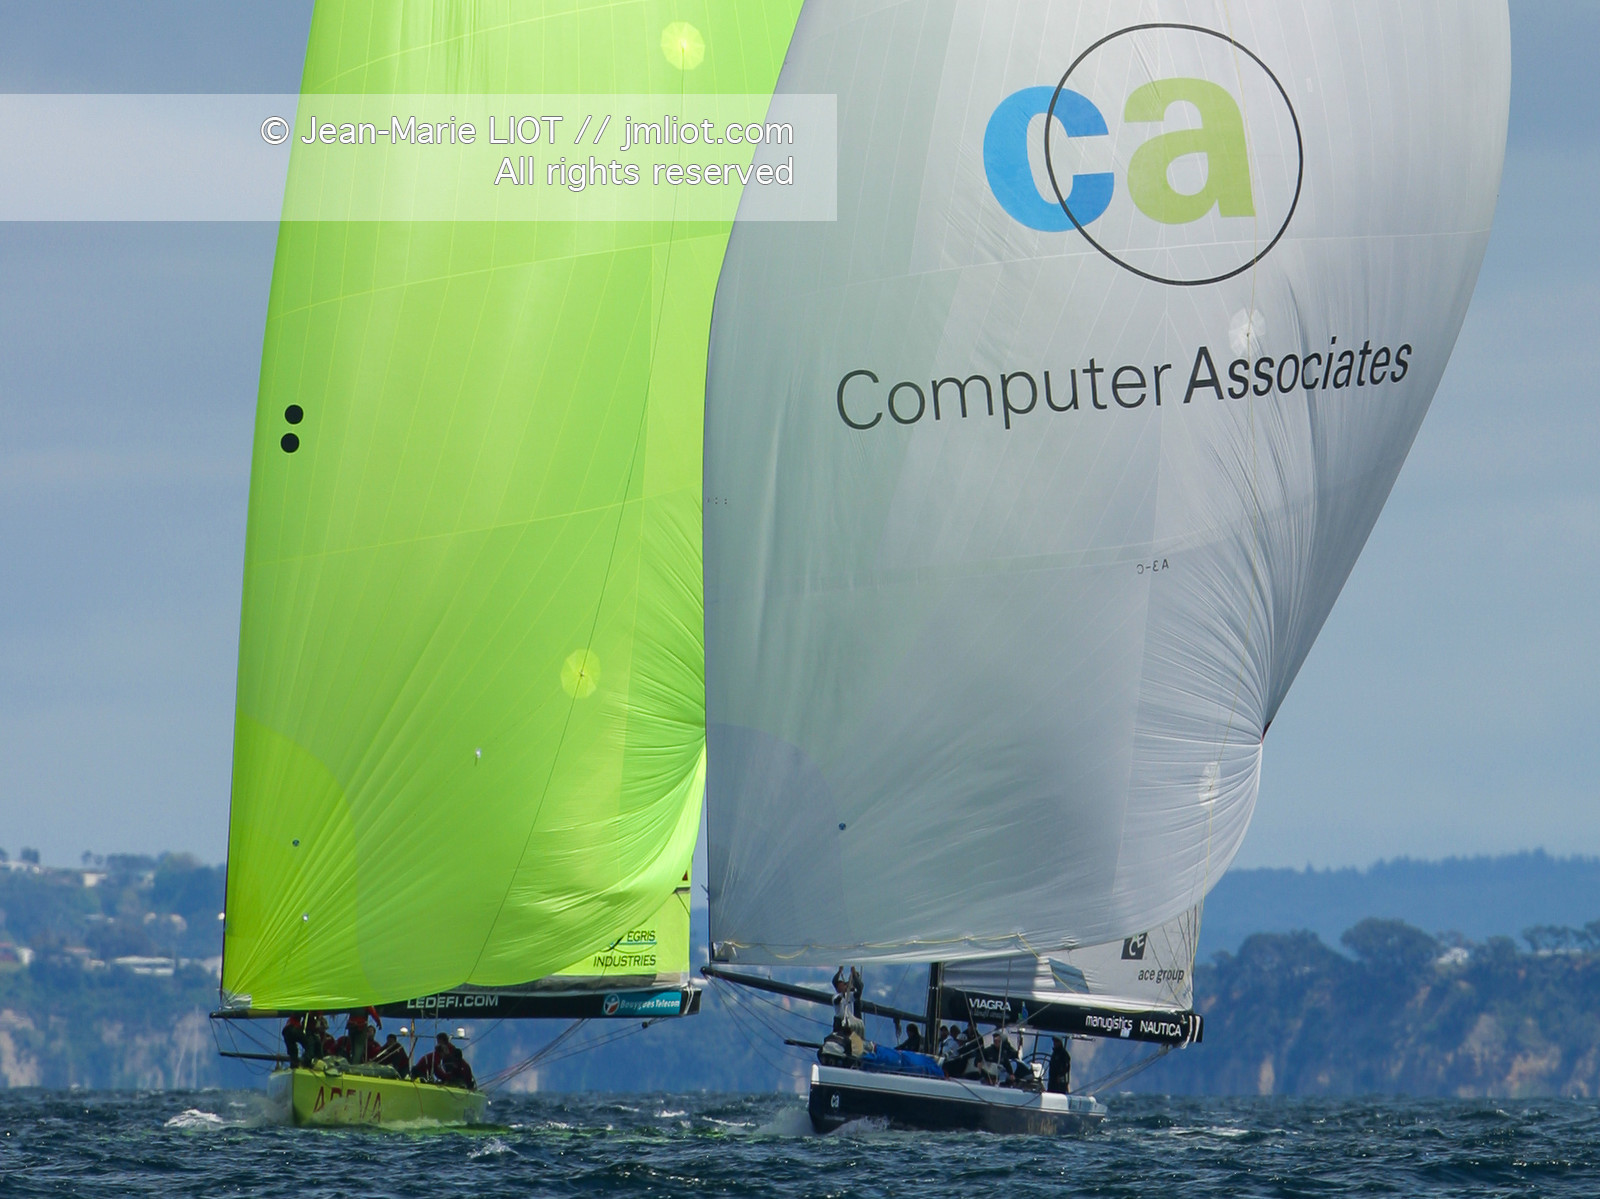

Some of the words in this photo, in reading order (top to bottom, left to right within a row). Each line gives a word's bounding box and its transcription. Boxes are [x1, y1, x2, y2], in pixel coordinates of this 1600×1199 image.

[983, 77, 1256, 233] ca
[836, 357, 1172, 430] Computer
[1182, 335, 1413, 404] Associates
[622, 930, 656, 943] EGRIS
[593, 955, 656, 968] INDUSTRIES
[1138, 969, 1155, 981] ace
[1156, 969, 1184, 984] group
[406, 995, 499, 1009] LEDEFI.COM
[969, 998, 1011, 1012] VIAGRA
[1085, 1015, 1133, 1032] manugistics
[1139, 1020, 1182, 1037] NAUTICA
